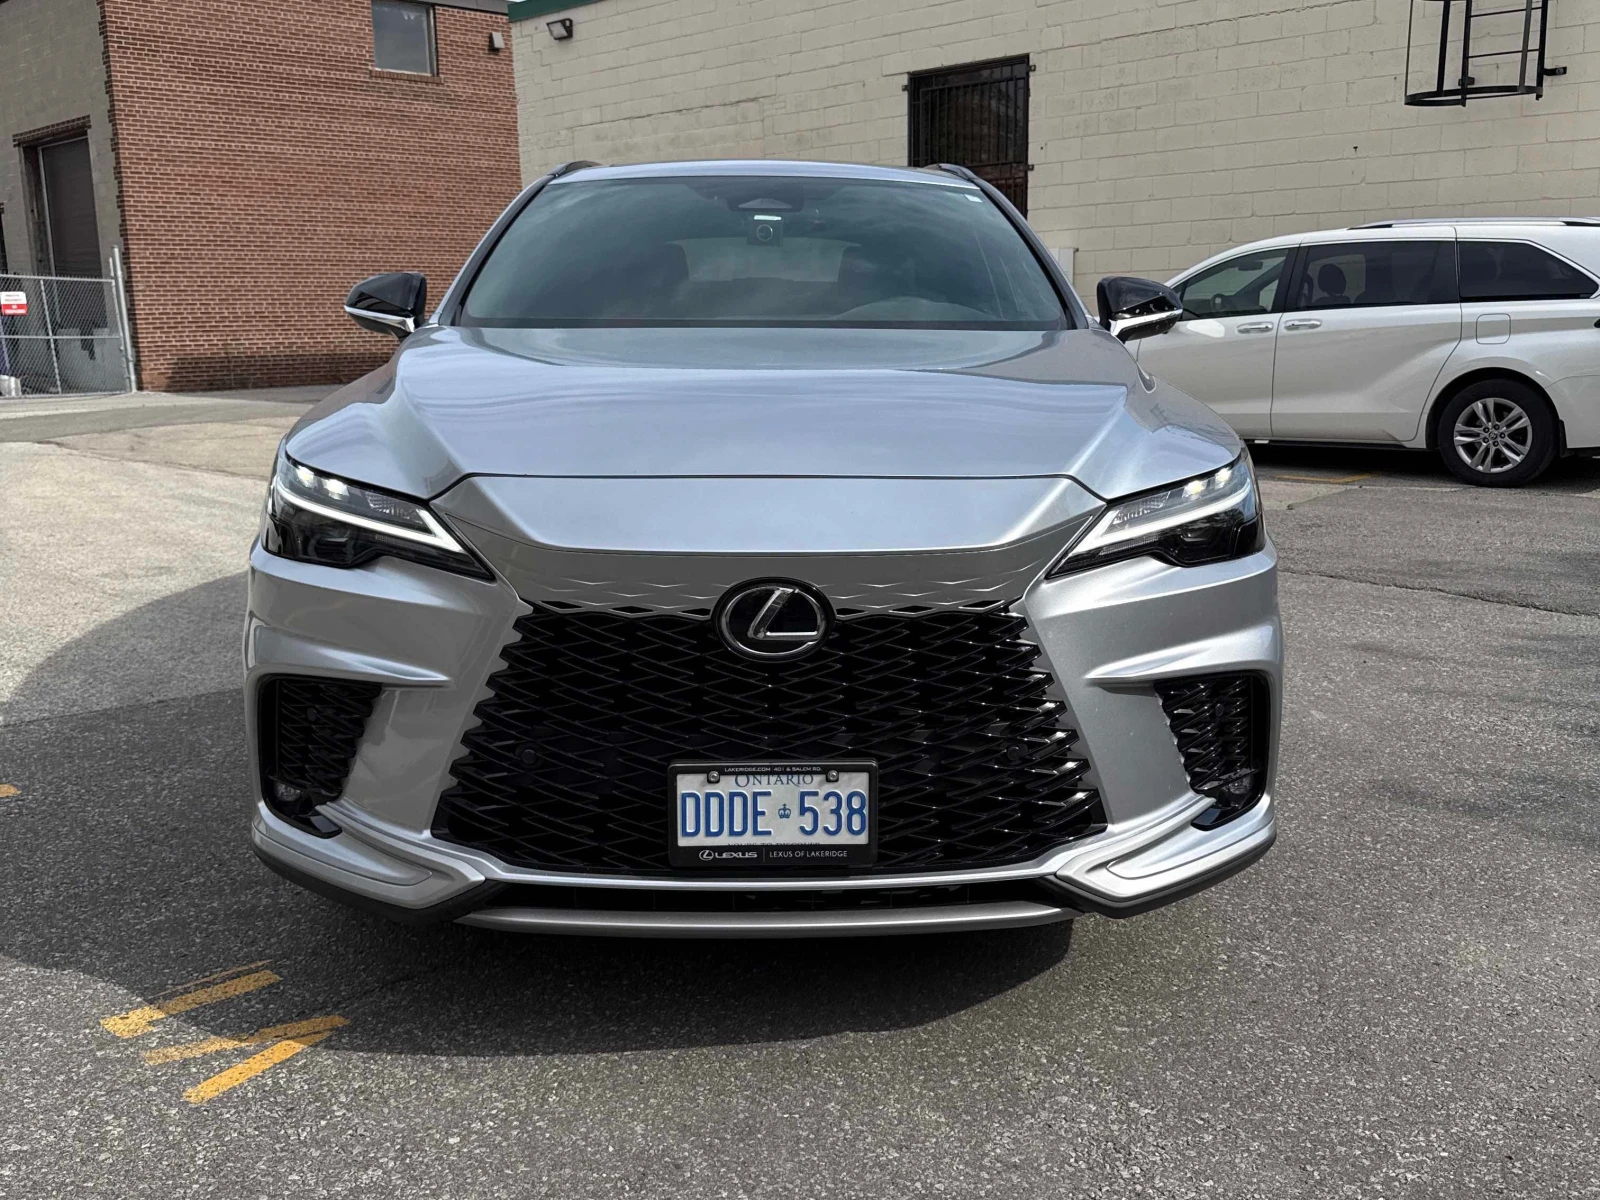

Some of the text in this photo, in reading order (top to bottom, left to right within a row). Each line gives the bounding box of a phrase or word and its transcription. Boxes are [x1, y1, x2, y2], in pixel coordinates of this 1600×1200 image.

[734, 774, 814, 788] ONTARIO
[681, 790, 867, 838] DDDE 538
[715, 851, 758, 859] LEXUS
[769, 850, 793, 858] LEXUS
[806, 850, 848, 858] LAKERIDGE
